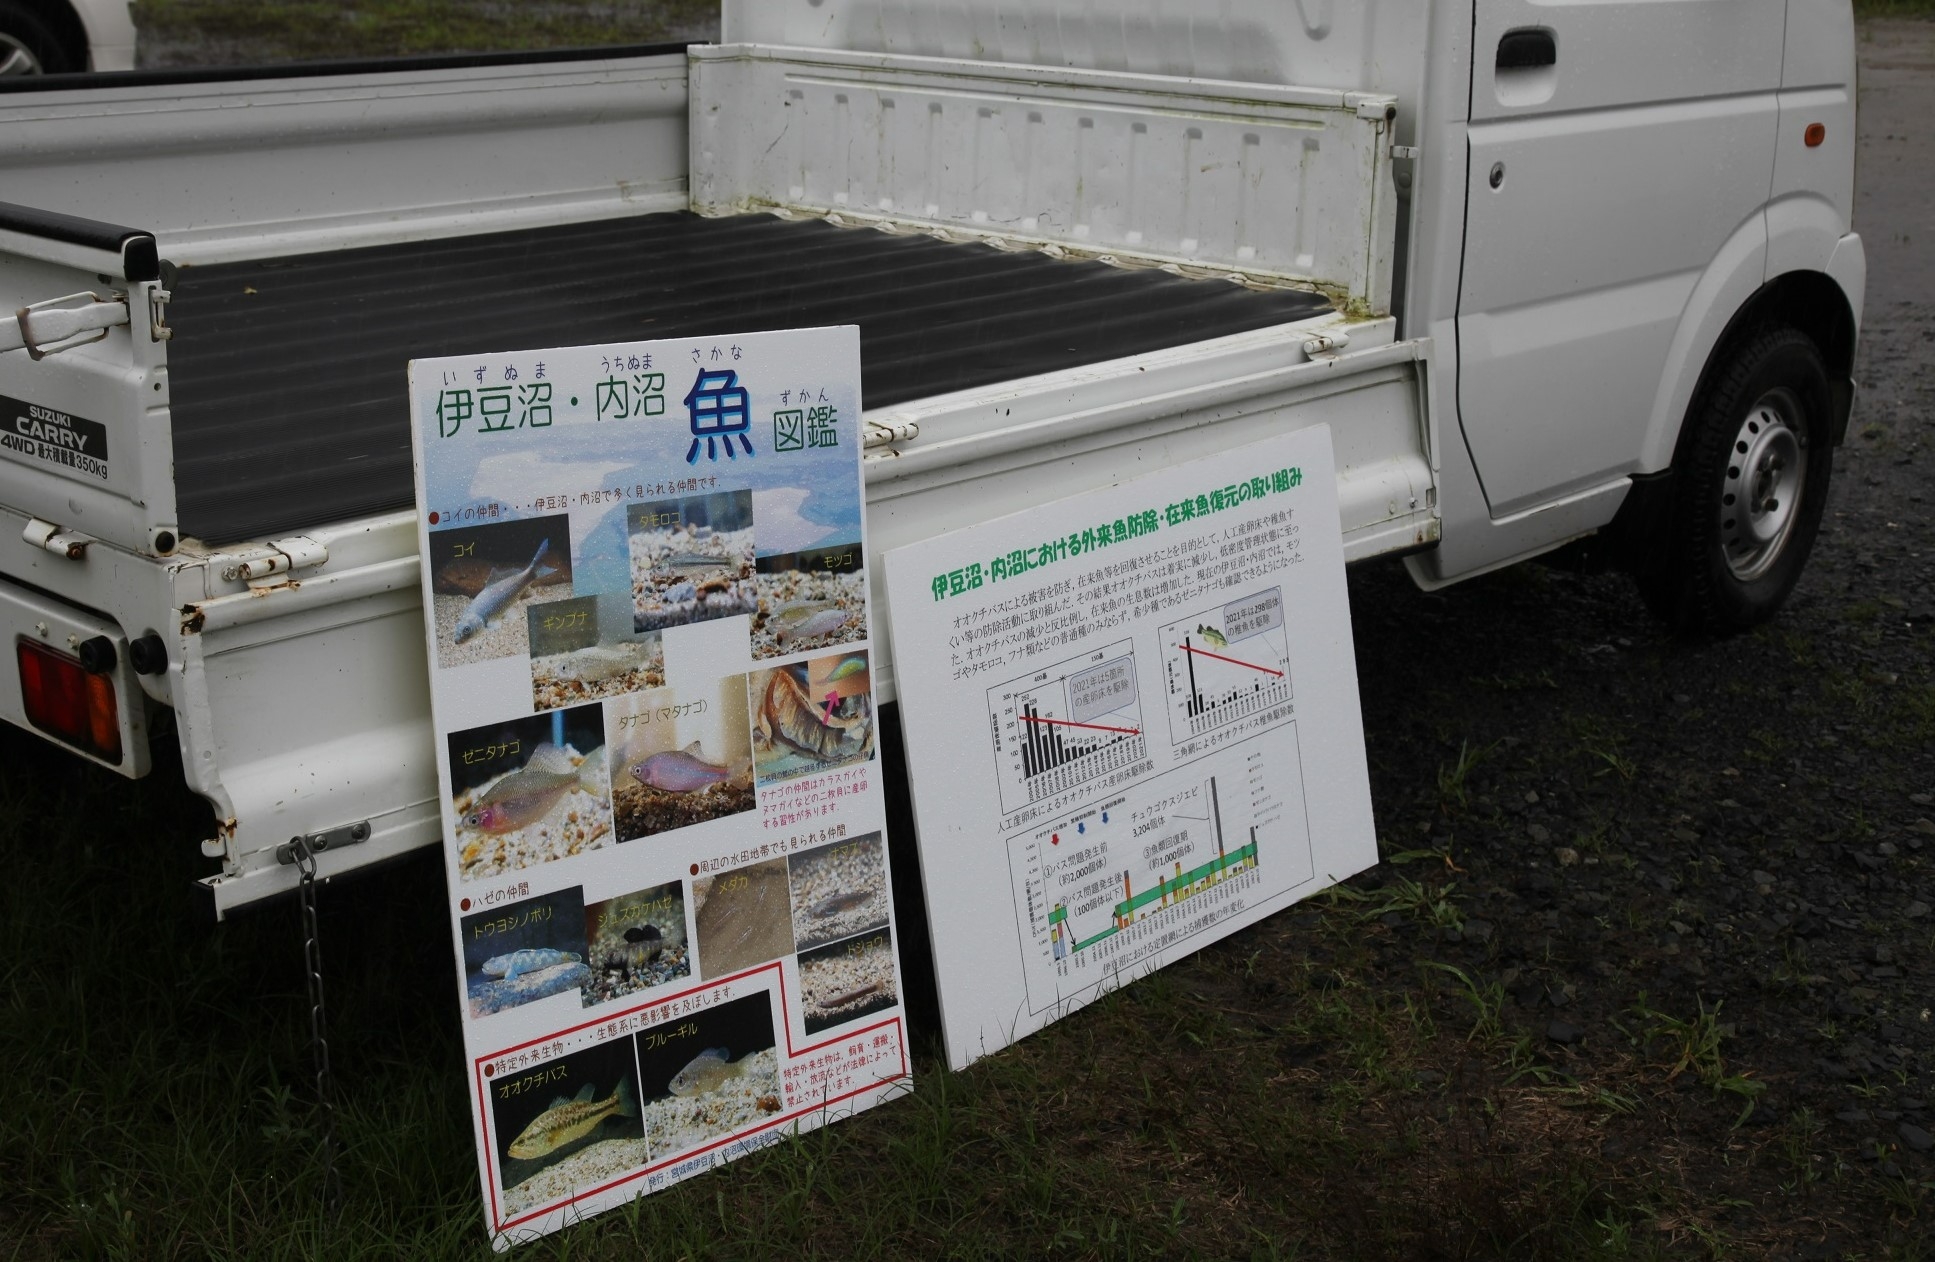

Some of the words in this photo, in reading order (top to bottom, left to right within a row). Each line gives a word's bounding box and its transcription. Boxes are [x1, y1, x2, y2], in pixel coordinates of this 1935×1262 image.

[600, 351, 653, 373] うちぬま
[691, 344, 742, 364] さかな
[442, 360, 547, 386] いずぬま
[779, 385, 829, 406] ずかん
[29, 405, 72, 428] SUZUKI
[433, 369, 667, 439] 伊豆沼・内沼
[680, 364, 755, 464] 魚
[772, 404, 839, 453] 図鑑
[16, 416, 88, 451] CARRY
[1, 434, 35, 455] 4WD
[38, 442, 108, 480] 最大積載量350kg
[638, 510, 681, 531] タモロコ
[452, 540, 476, 559] コイ
[823, 550, 853, 570] モツゴ
[542, 609, 587, 633] ギンブナ
[1227, 613, 1270, 638] の稚魚を駆除
[1074, 678, 1129, 708] の産卵床を駆除
[1173, 703, 1294, 760] 三角網によるオオクチバス稚魚駆除数
[461, 737, 522, 767] ゼニタナゴ
[760, 765, 867, 803] タナゴの仲間はカラスガイや
[762, 779, 868, 817] ヌマガイなどの二枚貝に産卵
[996, 758, 1154, 834] 人工産卵床によるオオクチバス産卵床駆除数
[1130, 784, 1198, 823] チュウゴクスジエビ
[699, 822, 846, 875] 周辺の水田地帯でも見られる仲間
[471, 880, 530, 910] ハゼの仲間
[718, 873, 748, 895] メダカ
[473, 904, 553, 941] トウヨシノボリ
[846, 935, 883, 958] ドジョウ
[645, 1019, 697, 1051] ブルーギル
[498, 1062, 568, 1100] オオクチバス
